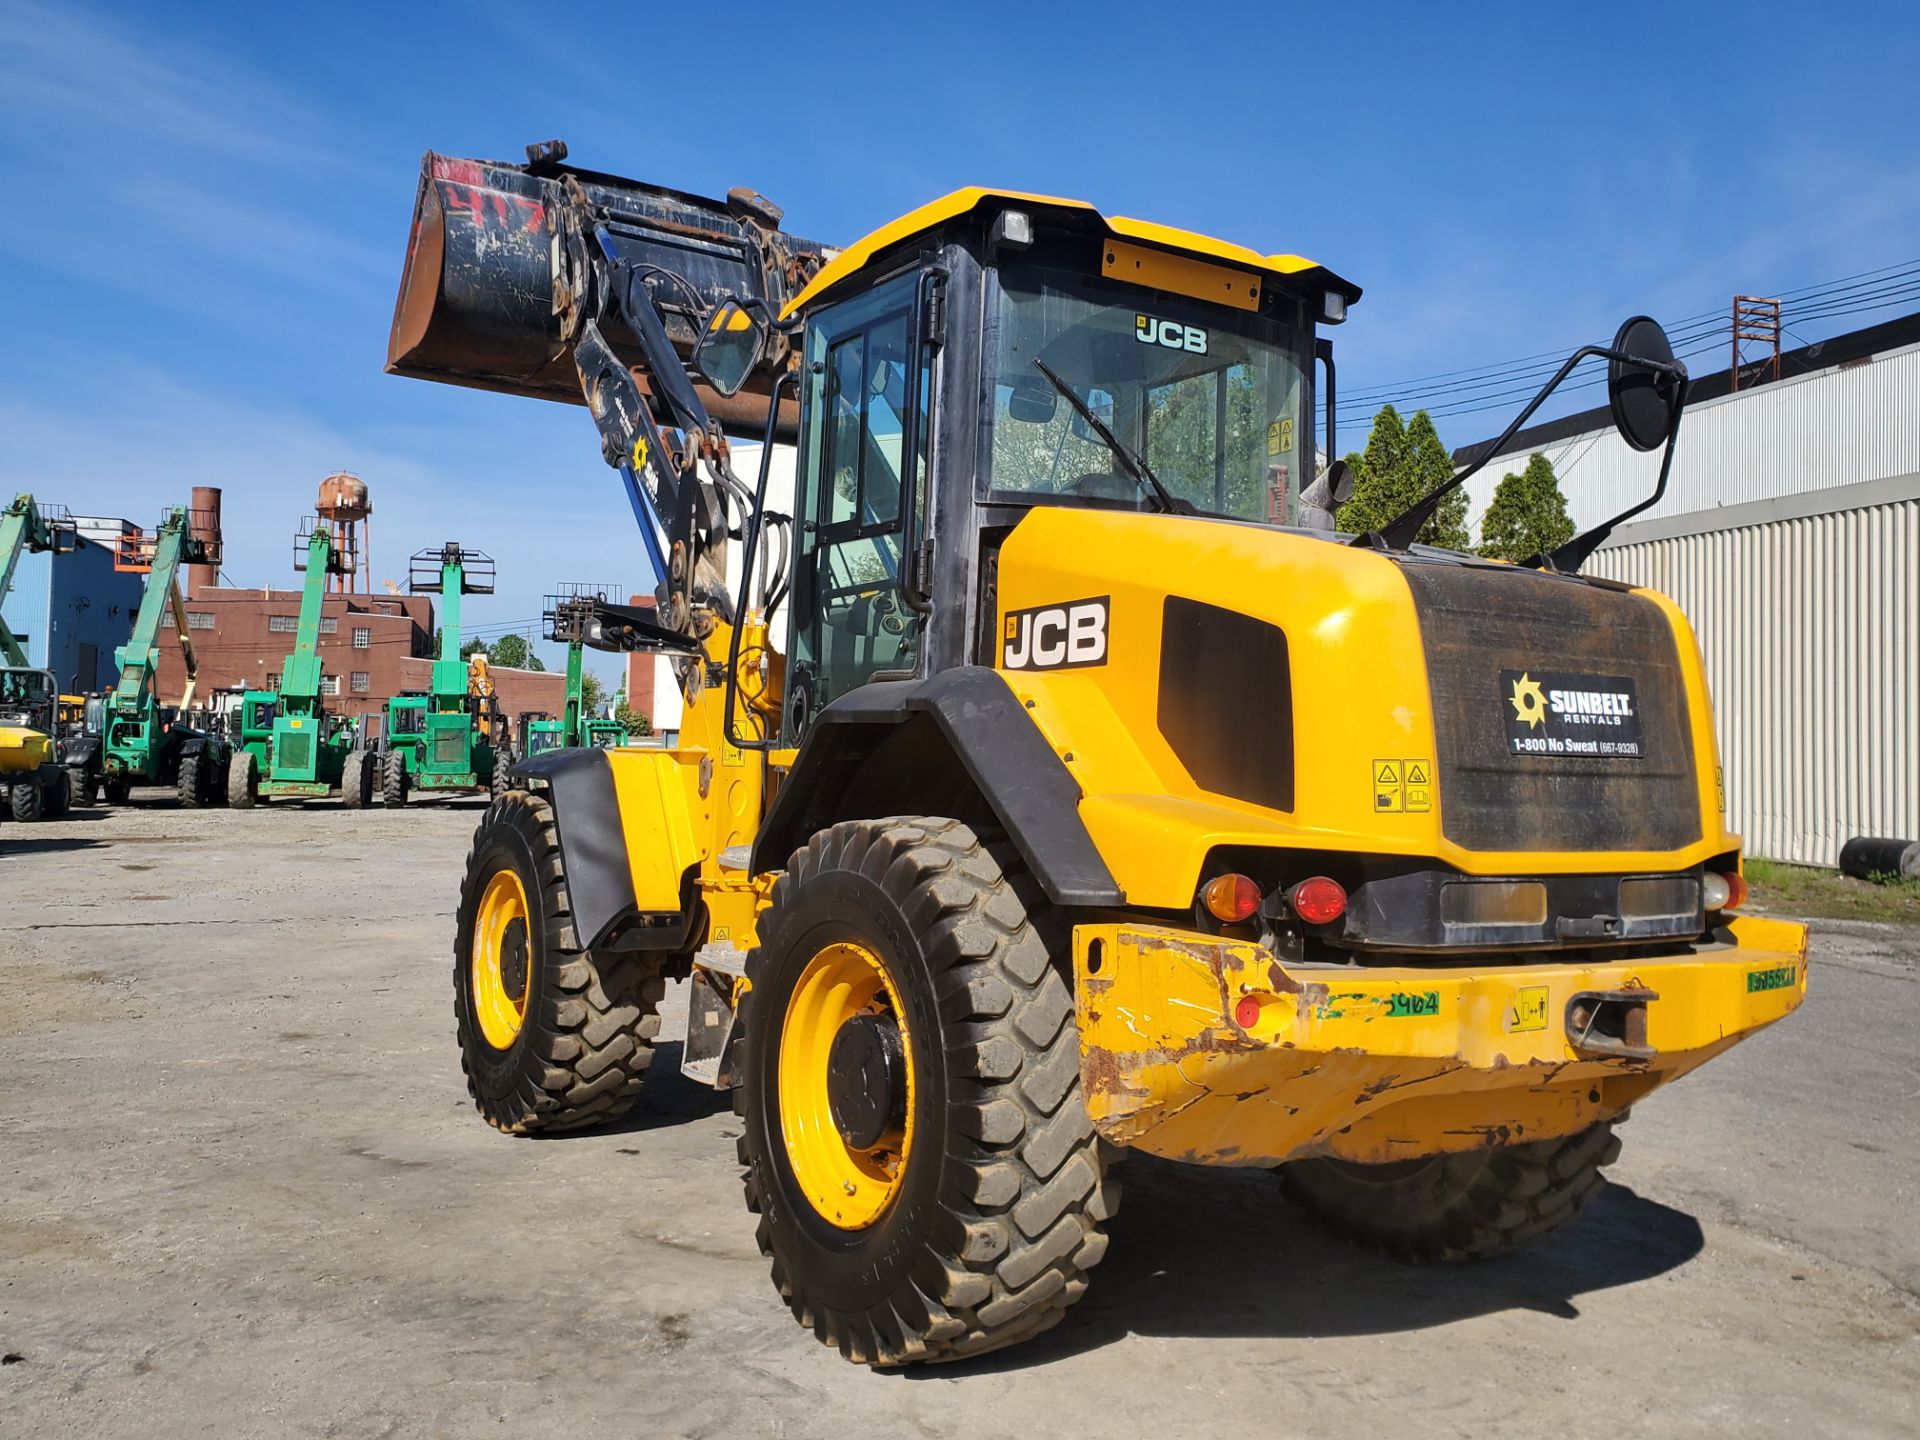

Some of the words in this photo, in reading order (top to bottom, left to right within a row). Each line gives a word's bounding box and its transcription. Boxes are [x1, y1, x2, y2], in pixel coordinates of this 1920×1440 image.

[445, 187, 546, 234] 417
[1136, 316, 1208, 354] JCB
[1005, 603, 1106, 669] JCB
[1549, 690, 1631, 716] SUNBELT
[1564, 715, 1622, 726] RENTALS
[1513, 738, 1546, 752] 1-800
[1548, 738, 1565, 752] No
[1565, 739, 1598, 753] Sweat
[1599, 741, 1639, 755] (667-9328)
